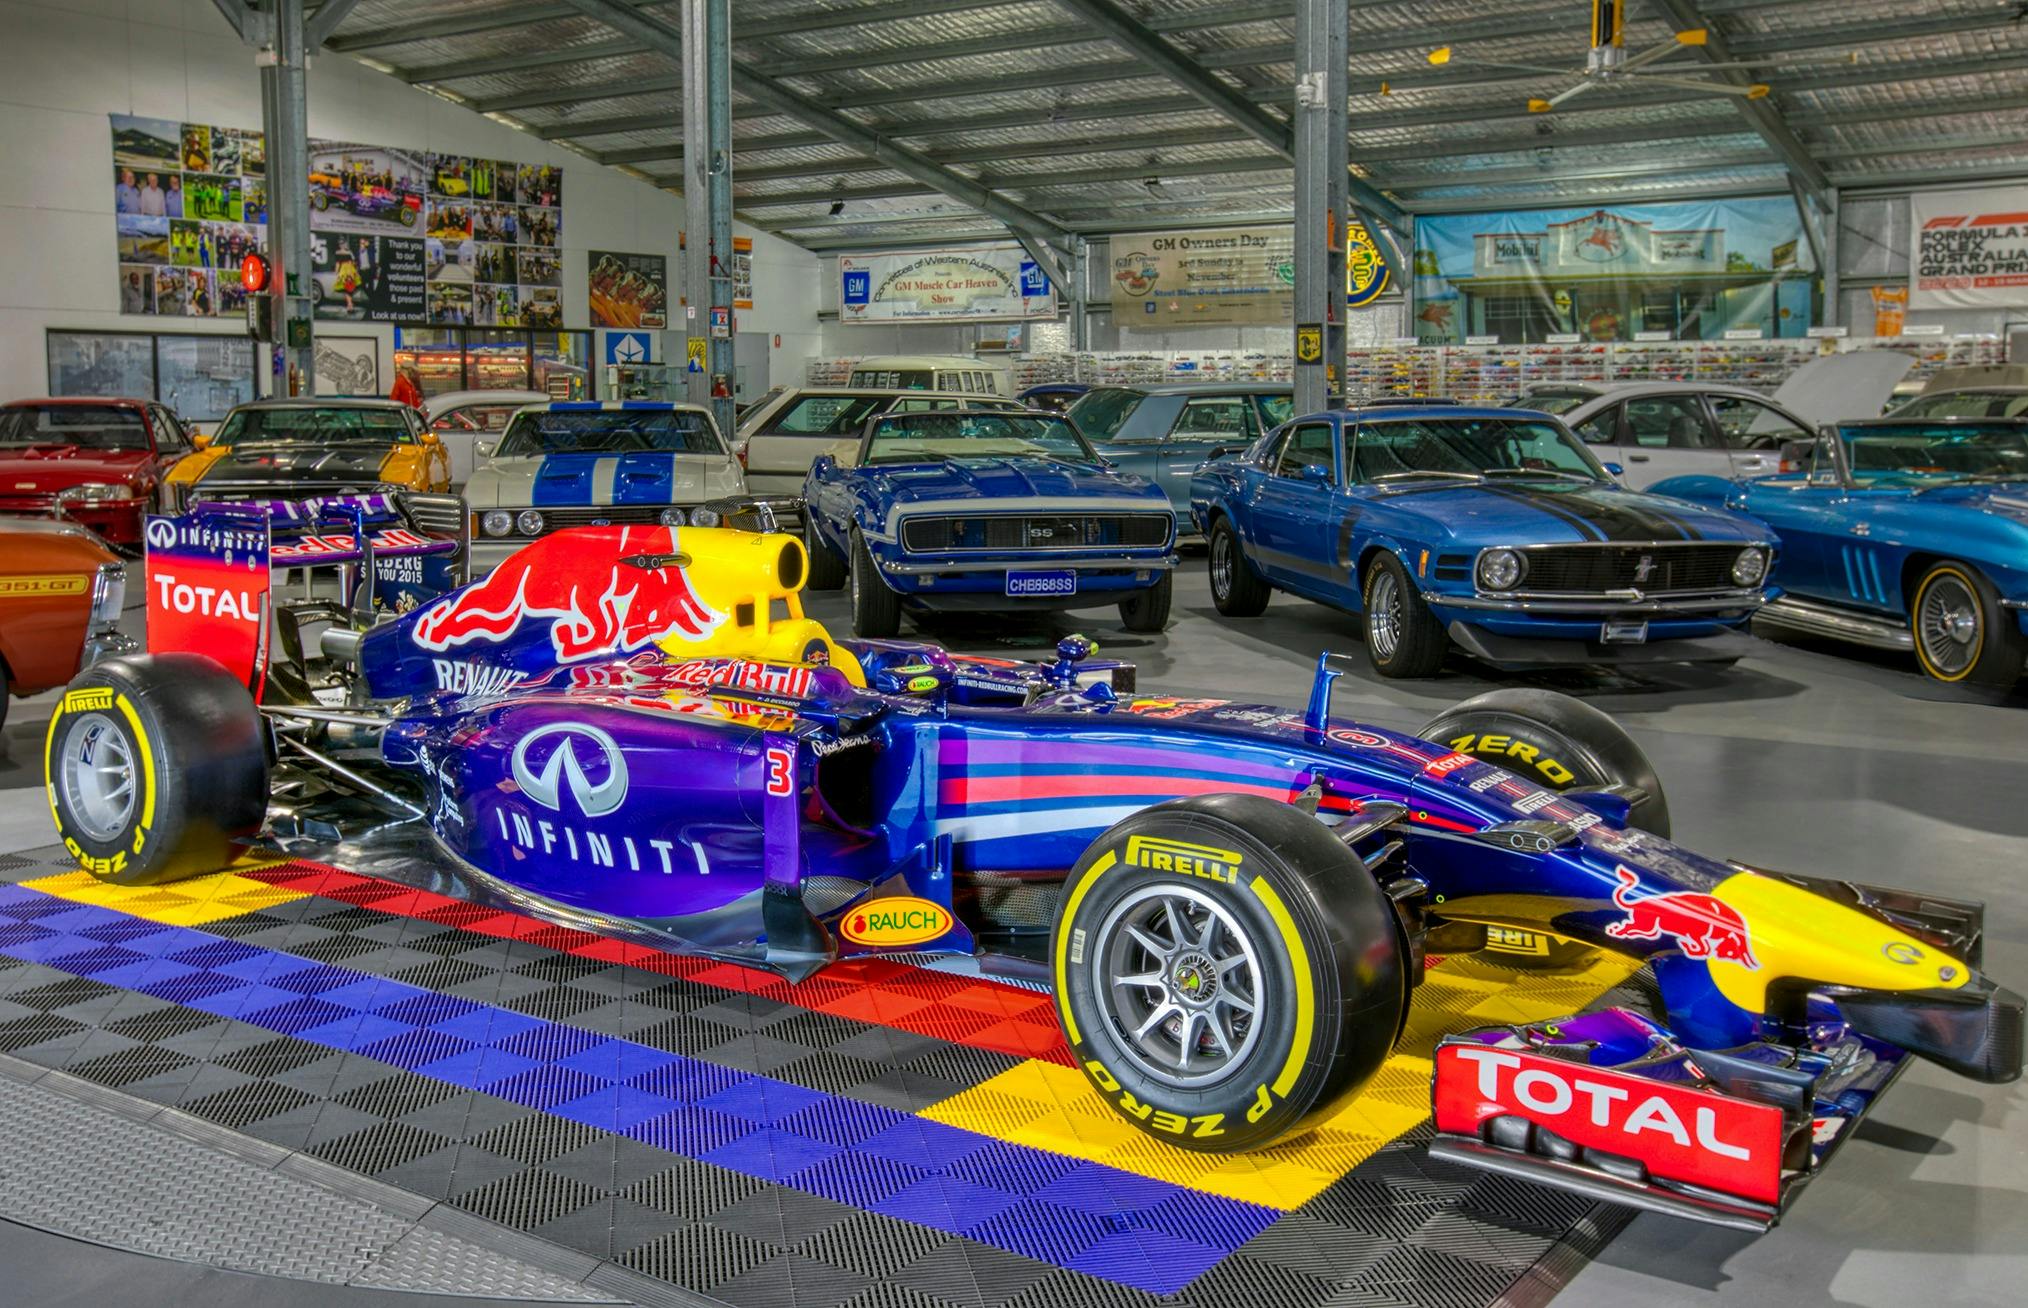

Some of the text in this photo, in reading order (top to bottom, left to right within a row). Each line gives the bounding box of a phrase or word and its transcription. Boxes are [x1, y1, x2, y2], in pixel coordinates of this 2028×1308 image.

[1152, 234, 1270, 250] GM Owners Day
[1921, 227, 2018, 242] FORMULA
[388, 239, 424, 251] Thank you
[1921, 240, 1984, 254] ROLEX
[395, 251, 404, 260] to
[1921, 249, 2028, 265] AUSTRALIA
[389, 262, 423, 271] wonderful
[1919, 263, 1988, 277] GRAND
[387, 273, 425, 282] volunteers
[895, 279, 998, 291] GM Muscle Car Heaven
[388, 283, 424, 293] those past
[848, 278, 864, 293] GM
[390, 294, 423, 304] & present
[931, 294, 955, 304] Show
[371, 310, 390, 319] Look
[390, 311, 398, 320] at
[1419, 335, 1451, 345] ACUUM
[1030, 528, 1053, 538] SS
[378, 568, 397, 581] YOU
[398, 570, 423, 584] 2015
[154, 574, 260, 621] TOTAL
[433, 659, 529, 696] RENAULT
[662, 658, 742, 688] Red
[739, 659, 812, 698] Bull
[64, 687, 114, 714] PIRELLI
[1450, 733, 1575, 785] ZERO
[766, 749, 793, 798] 3
[496, 806, 710, 875] INFINITI
[65, 825, 146, 875] P ZERO
[1124, 835, 1243, 885] PIRELLI
[869, 911, 936, 931] RAUCH
[1085, 1059, 1273, 1138] P ZERO
[1456, 1048, 1750, 1161] TOTAL
